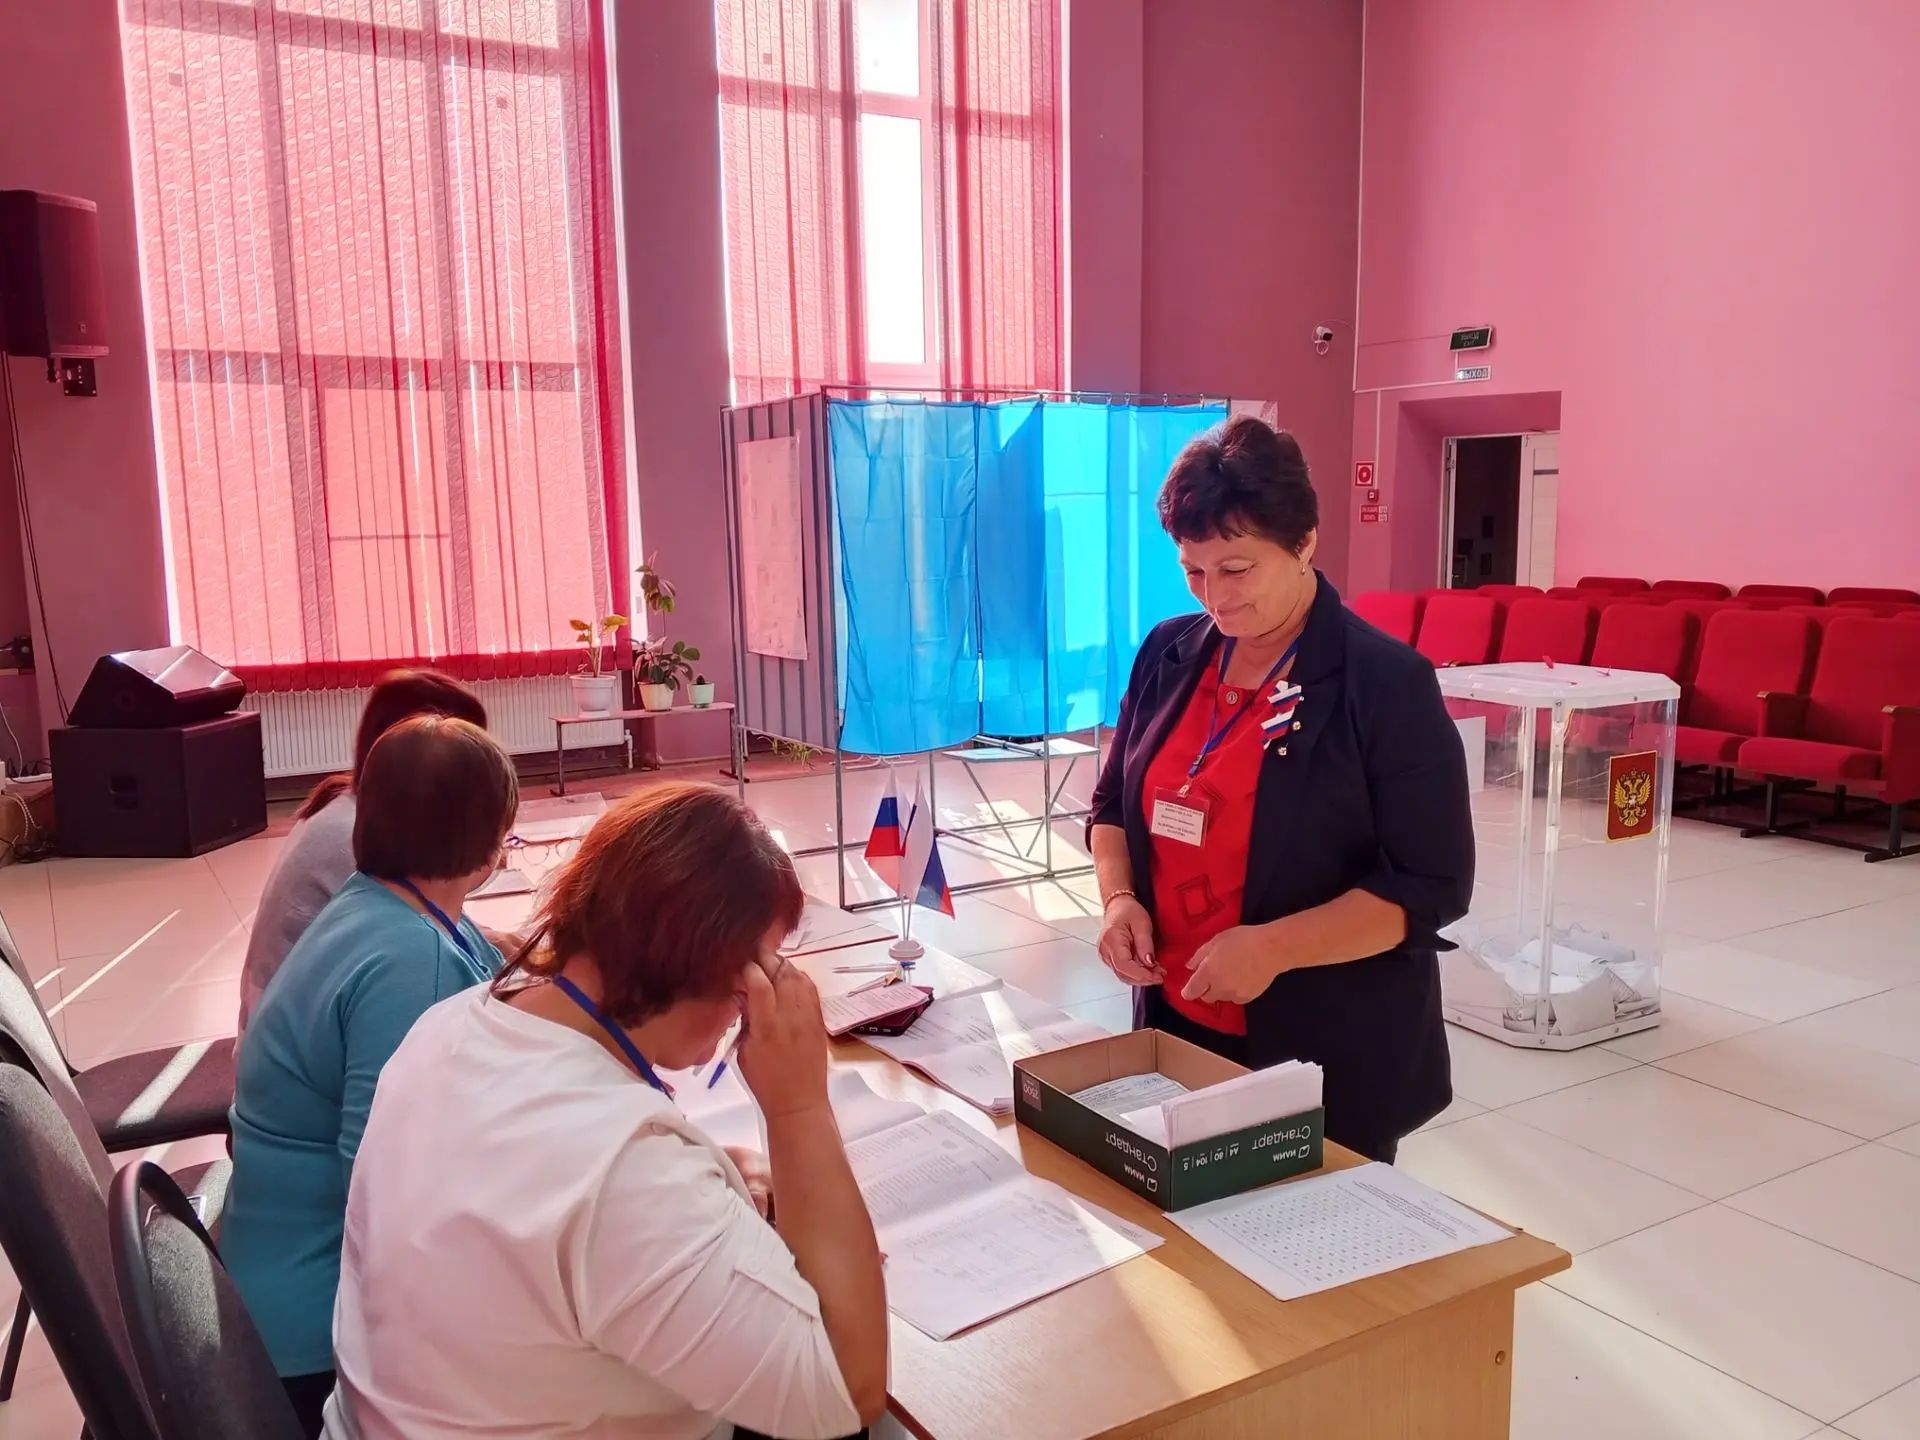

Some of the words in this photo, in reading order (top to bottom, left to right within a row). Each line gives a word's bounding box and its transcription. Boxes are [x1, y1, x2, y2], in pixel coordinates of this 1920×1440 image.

[1252, 1125, 1311, 1150] Стандарт
[1105, 1132, 1157, 1172] Стандарт
[1272, 1149, 1297, 1162] ИЛИМ
[1124, 1162, 1145, 1183] ИЛИМ
